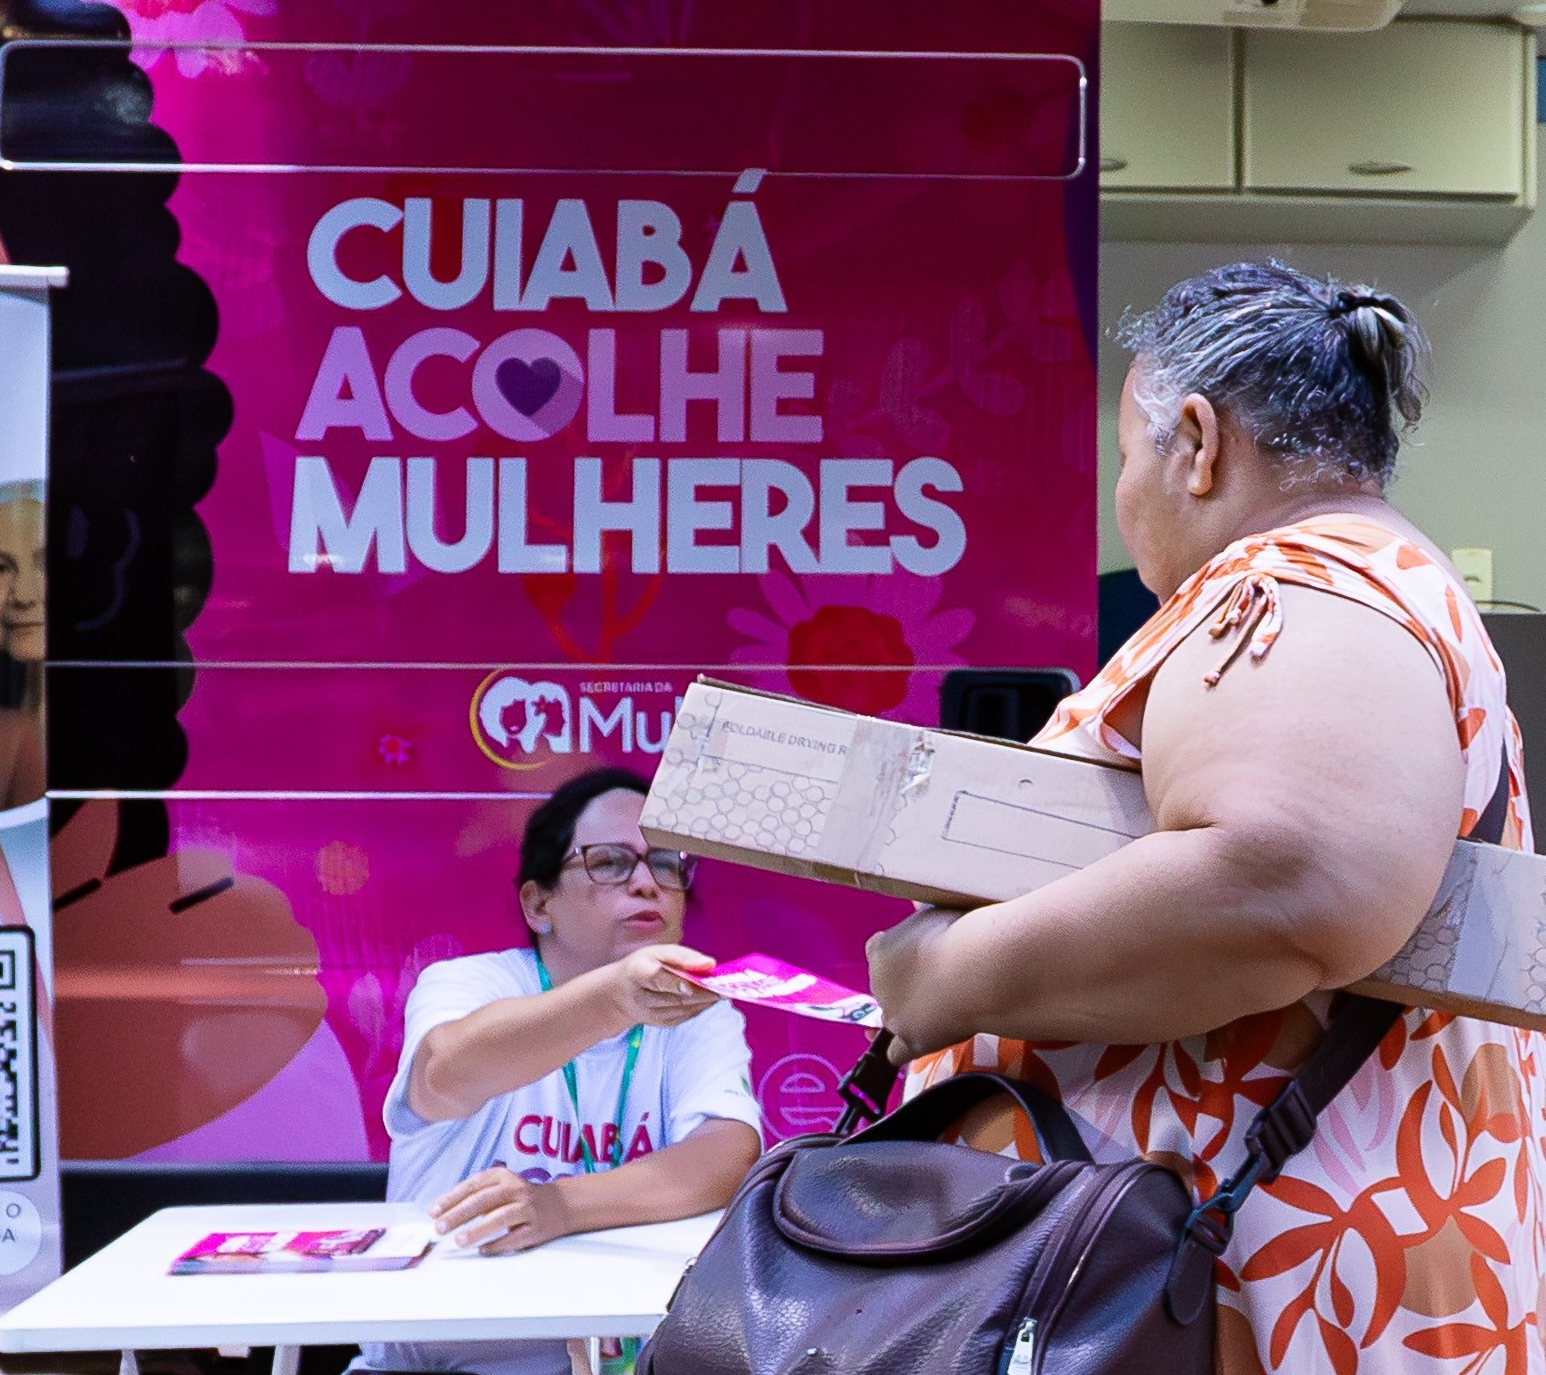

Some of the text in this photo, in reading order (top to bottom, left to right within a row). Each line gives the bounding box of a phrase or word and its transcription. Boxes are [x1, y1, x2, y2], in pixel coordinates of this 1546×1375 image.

[305, 167, 787, 313] CUIABÁ
[294, 326, 824, 443] ACOLHE
[287, 456, 968, 577] MULHERES
[514, 1112, 653, 1163] CUIABÁ
[6, 1202, 21, 1218] O
